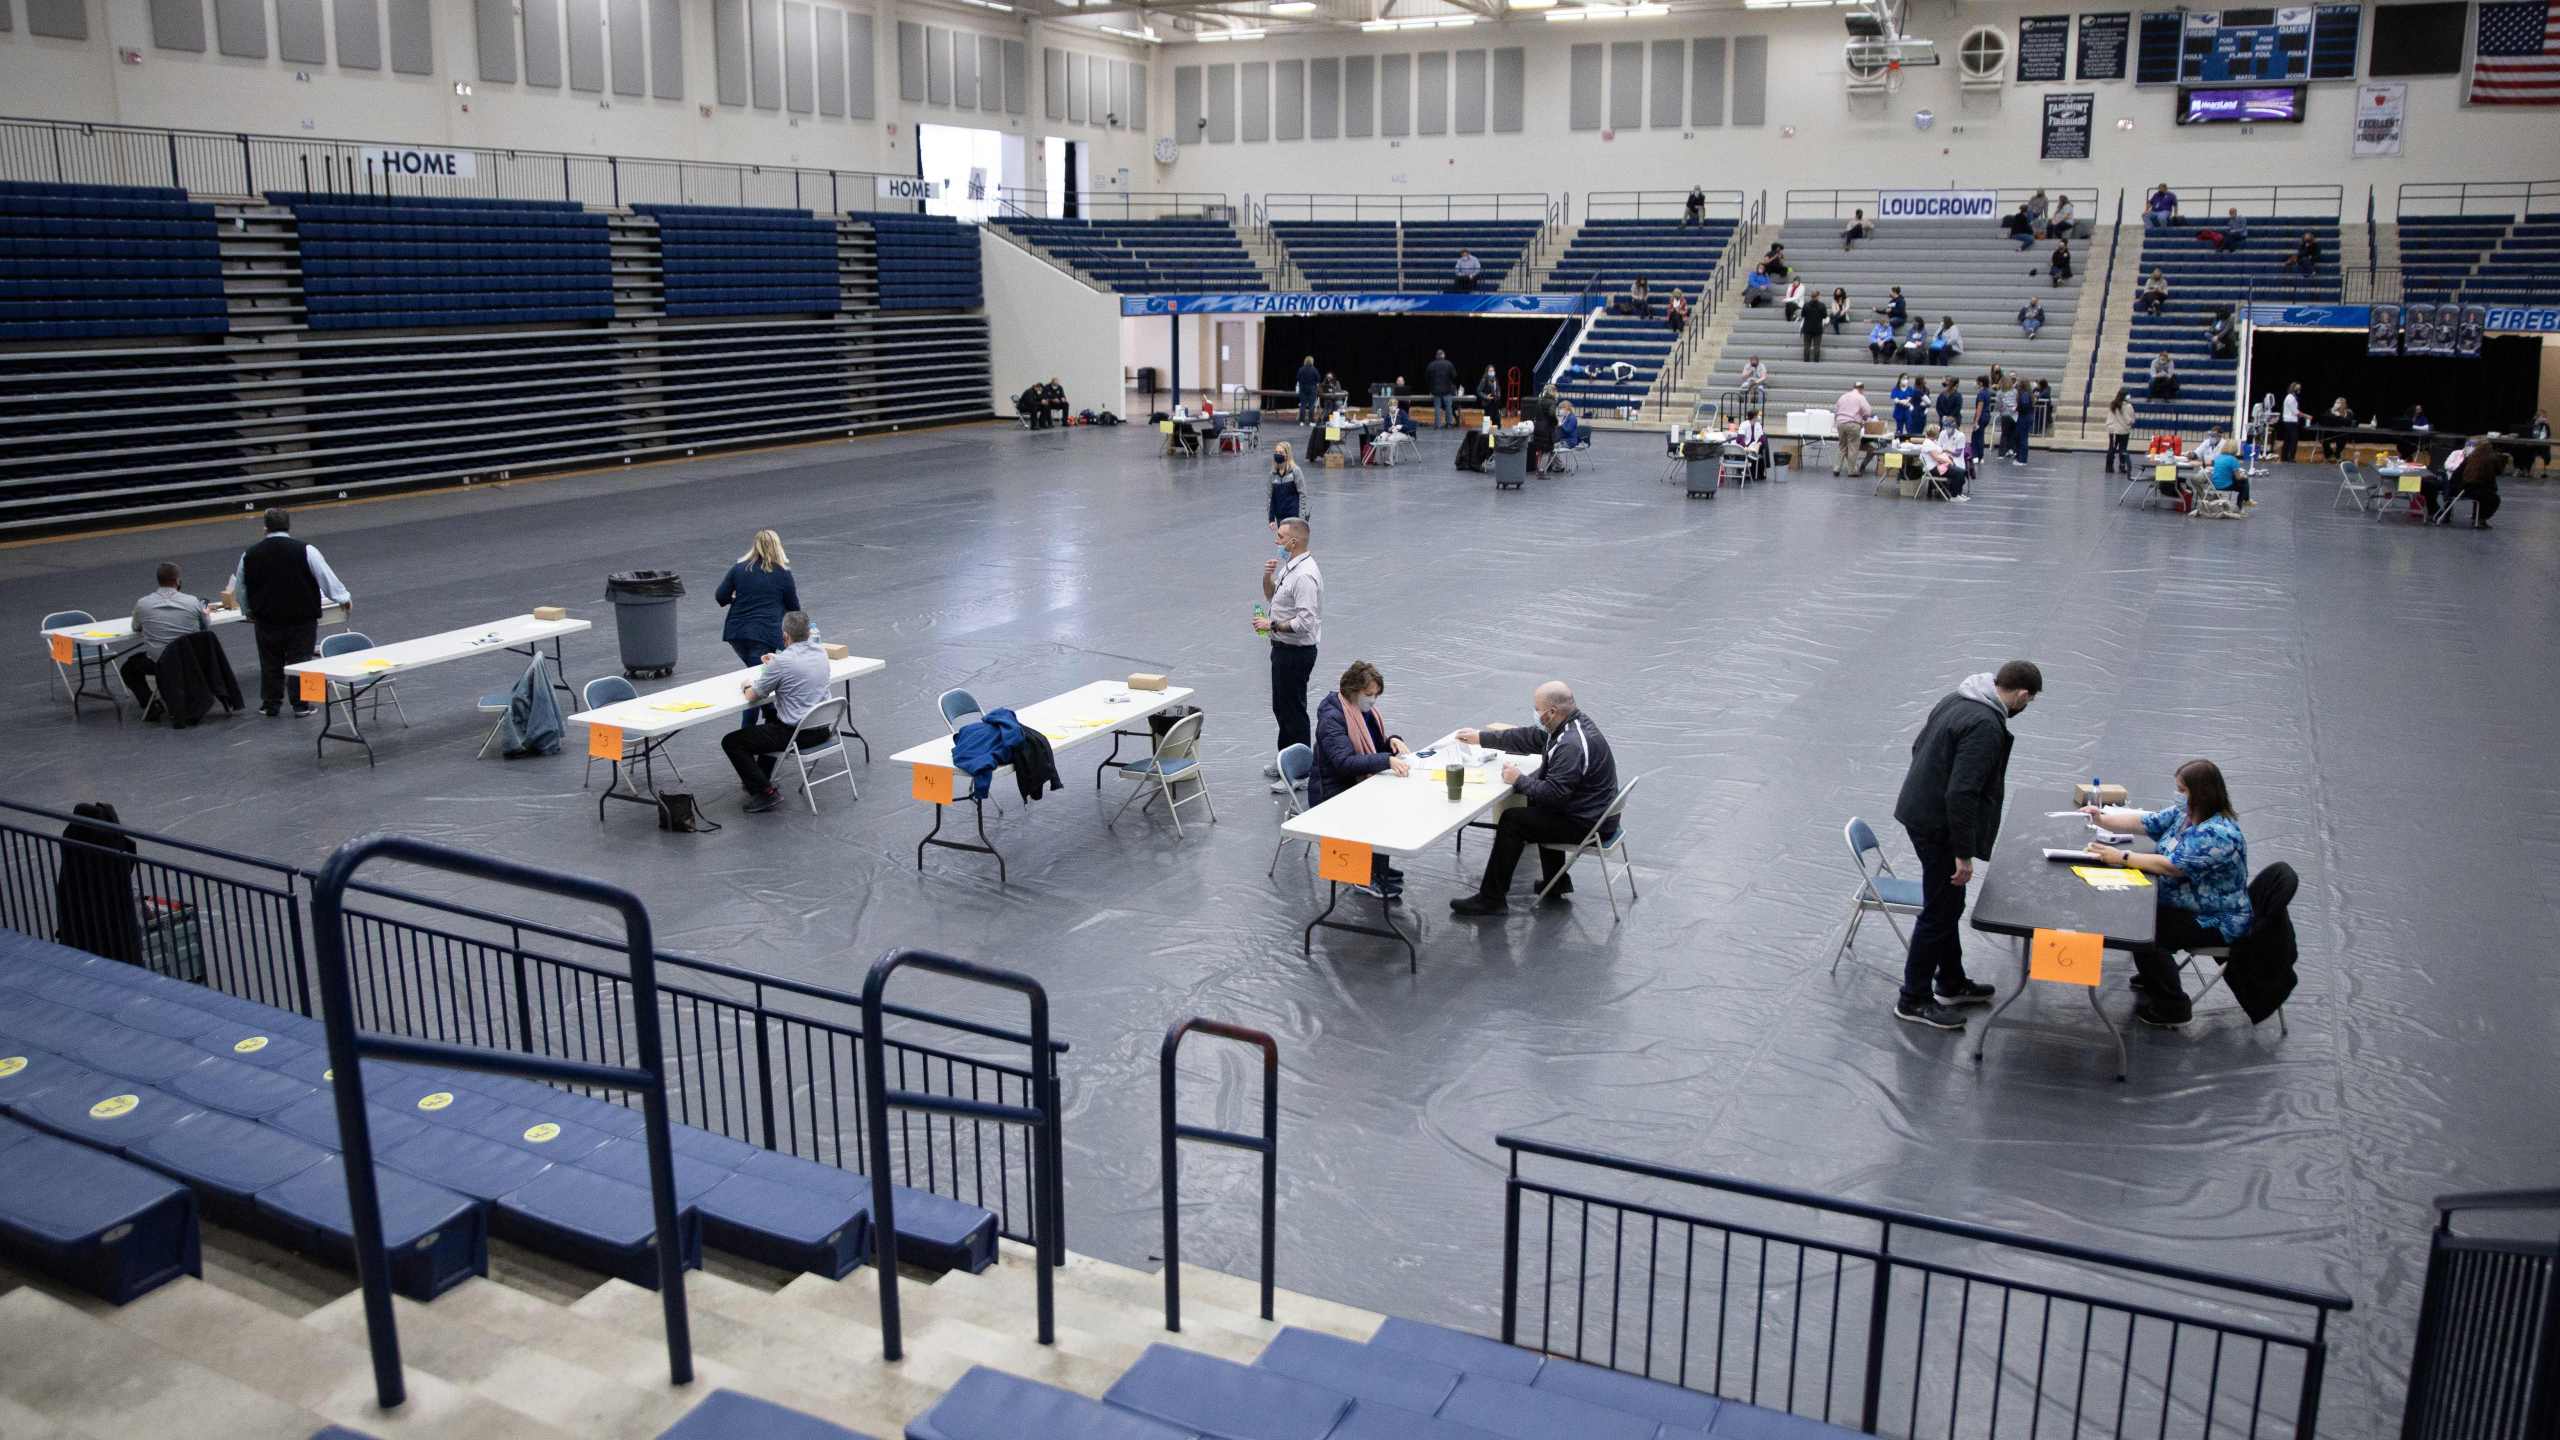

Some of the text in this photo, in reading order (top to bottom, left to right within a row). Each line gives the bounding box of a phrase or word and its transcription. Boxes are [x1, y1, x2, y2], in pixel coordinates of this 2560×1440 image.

[383, 151, 457, 175] HOME
[889, 180, 930, 198] HOME
[1881, 197, 1994, 215] LOUDCROWD
[1253, 294, 1361, 311] FAIRMONT
[2486, 310, 2560, 329] FIREB
